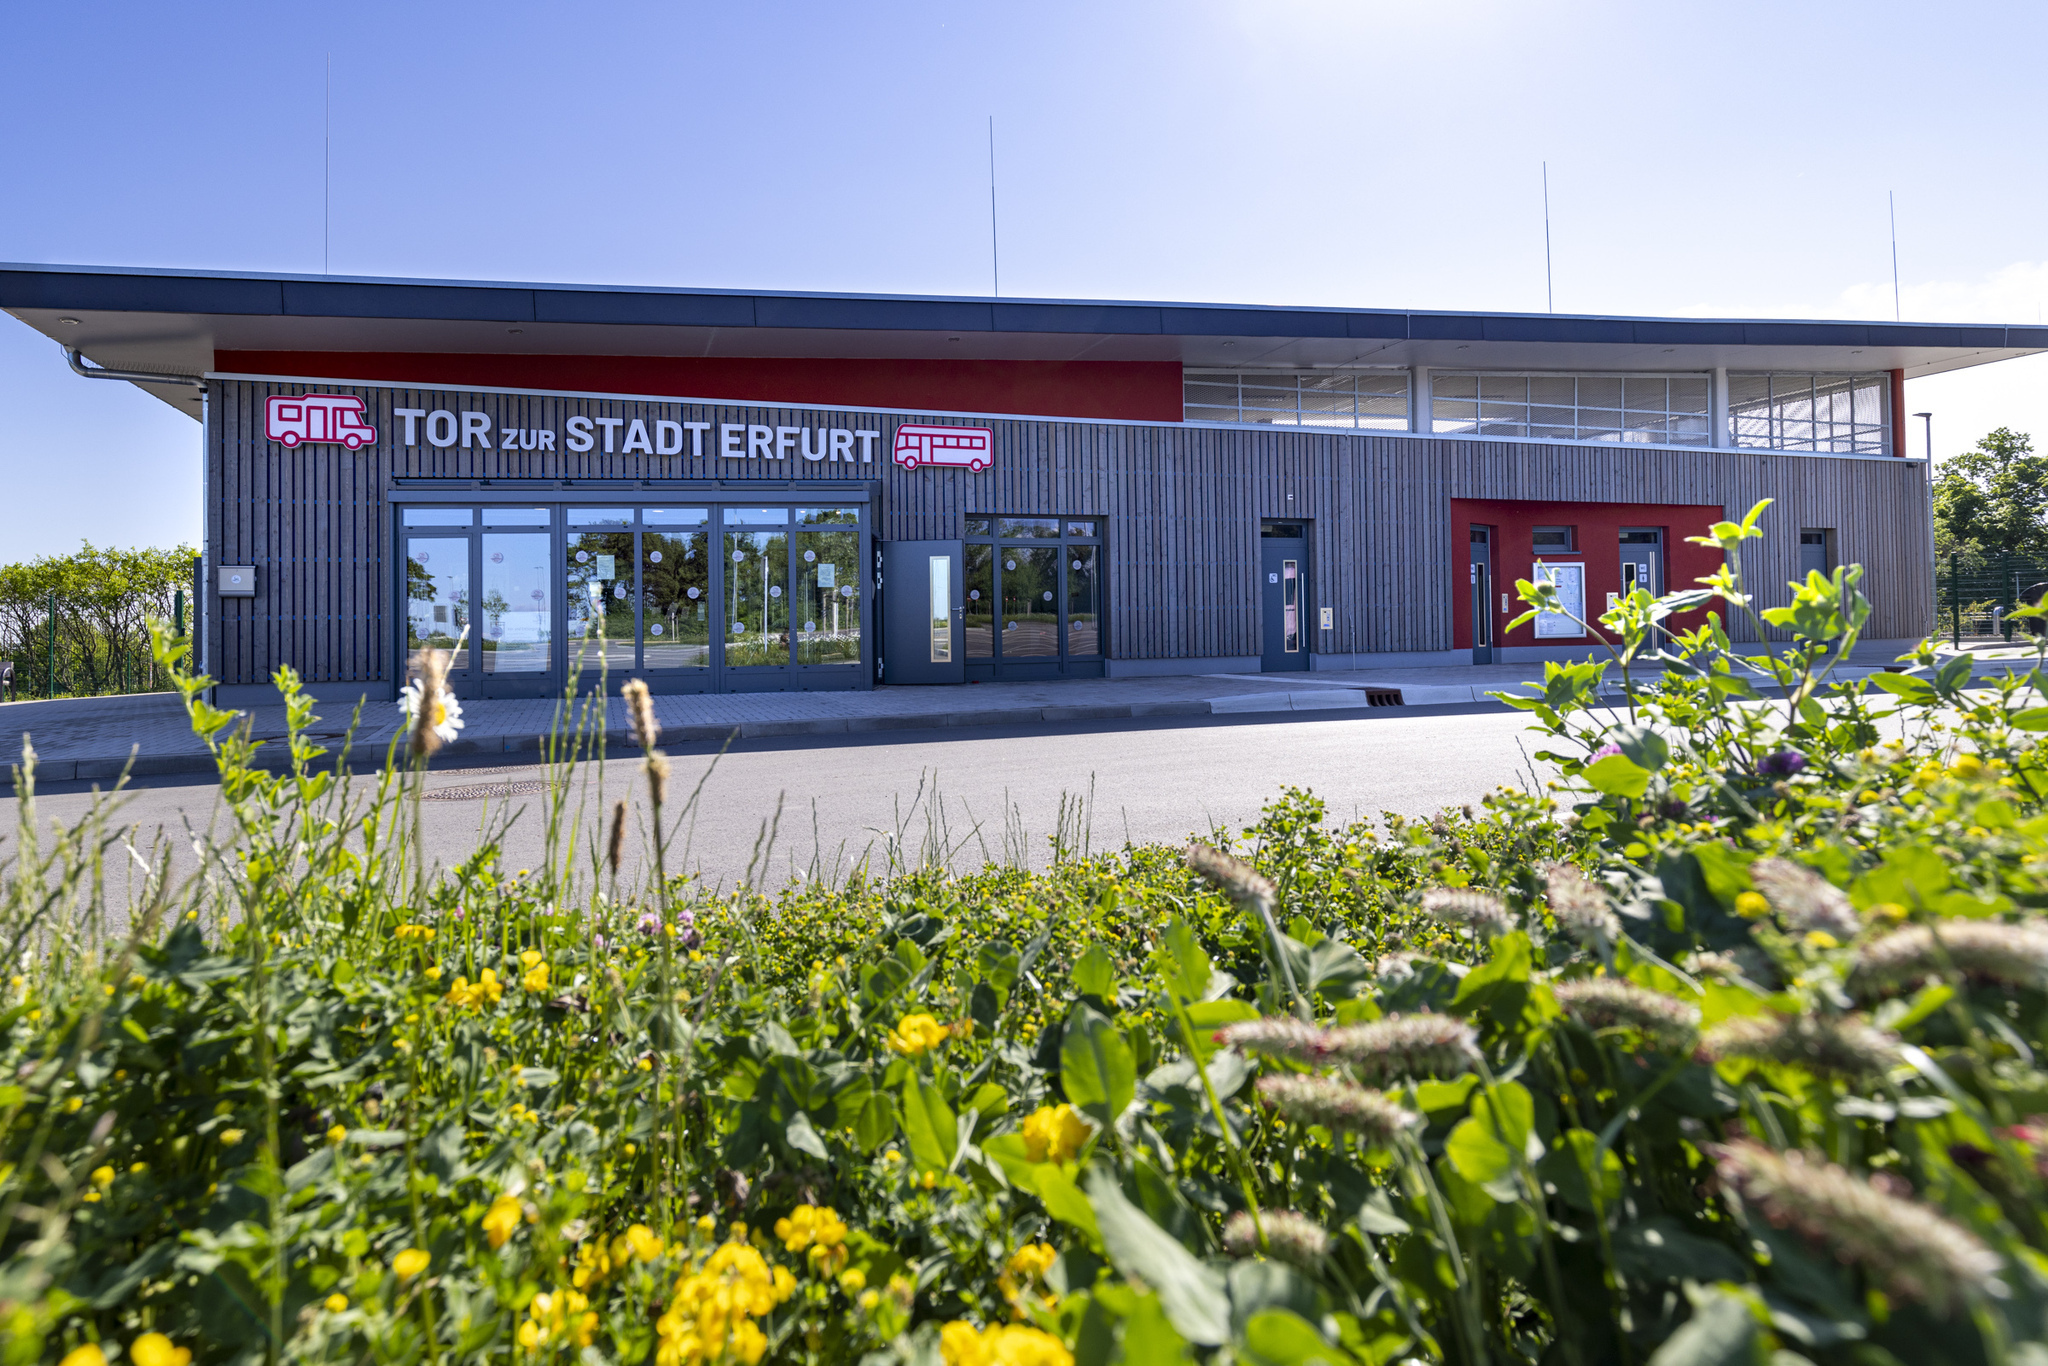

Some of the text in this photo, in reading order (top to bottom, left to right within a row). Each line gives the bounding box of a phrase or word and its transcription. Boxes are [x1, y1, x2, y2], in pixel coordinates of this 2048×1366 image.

[394, 408, 880, 463] TOR ZUR STADT ERFURT
